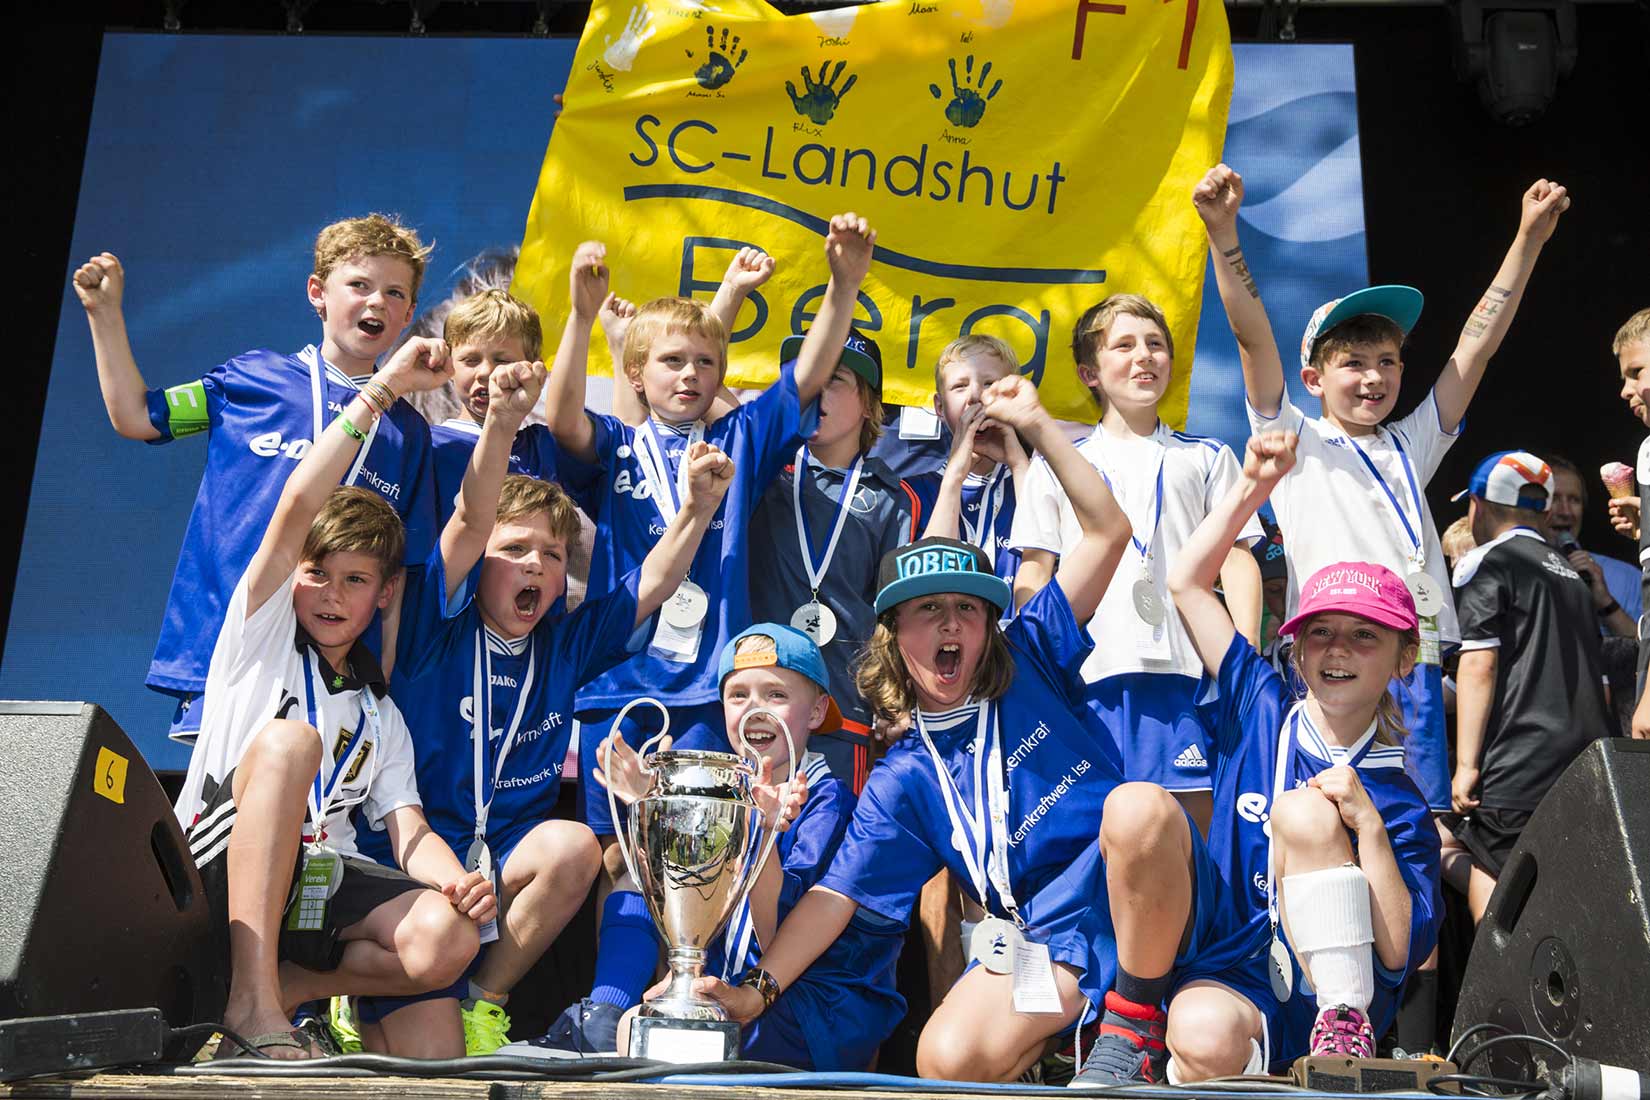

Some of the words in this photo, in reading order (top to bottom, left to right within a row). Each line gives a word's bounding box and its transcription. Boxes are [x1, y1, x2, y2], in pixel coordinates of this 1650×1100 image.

[629, 114, 1066, 214] SC-Landshut
[678, 236, 1051, 388] Berg
[358, 464, 402, 500] ernkraft
[904, 551, 972, 577] OBEY
[1311, 570, 1345, 599] NEW
[1345, 569, 1383, 598] YORK
[105, 760, 115, 789] 6
[1006, 773, 1077, 848] Kernkraftwerk
